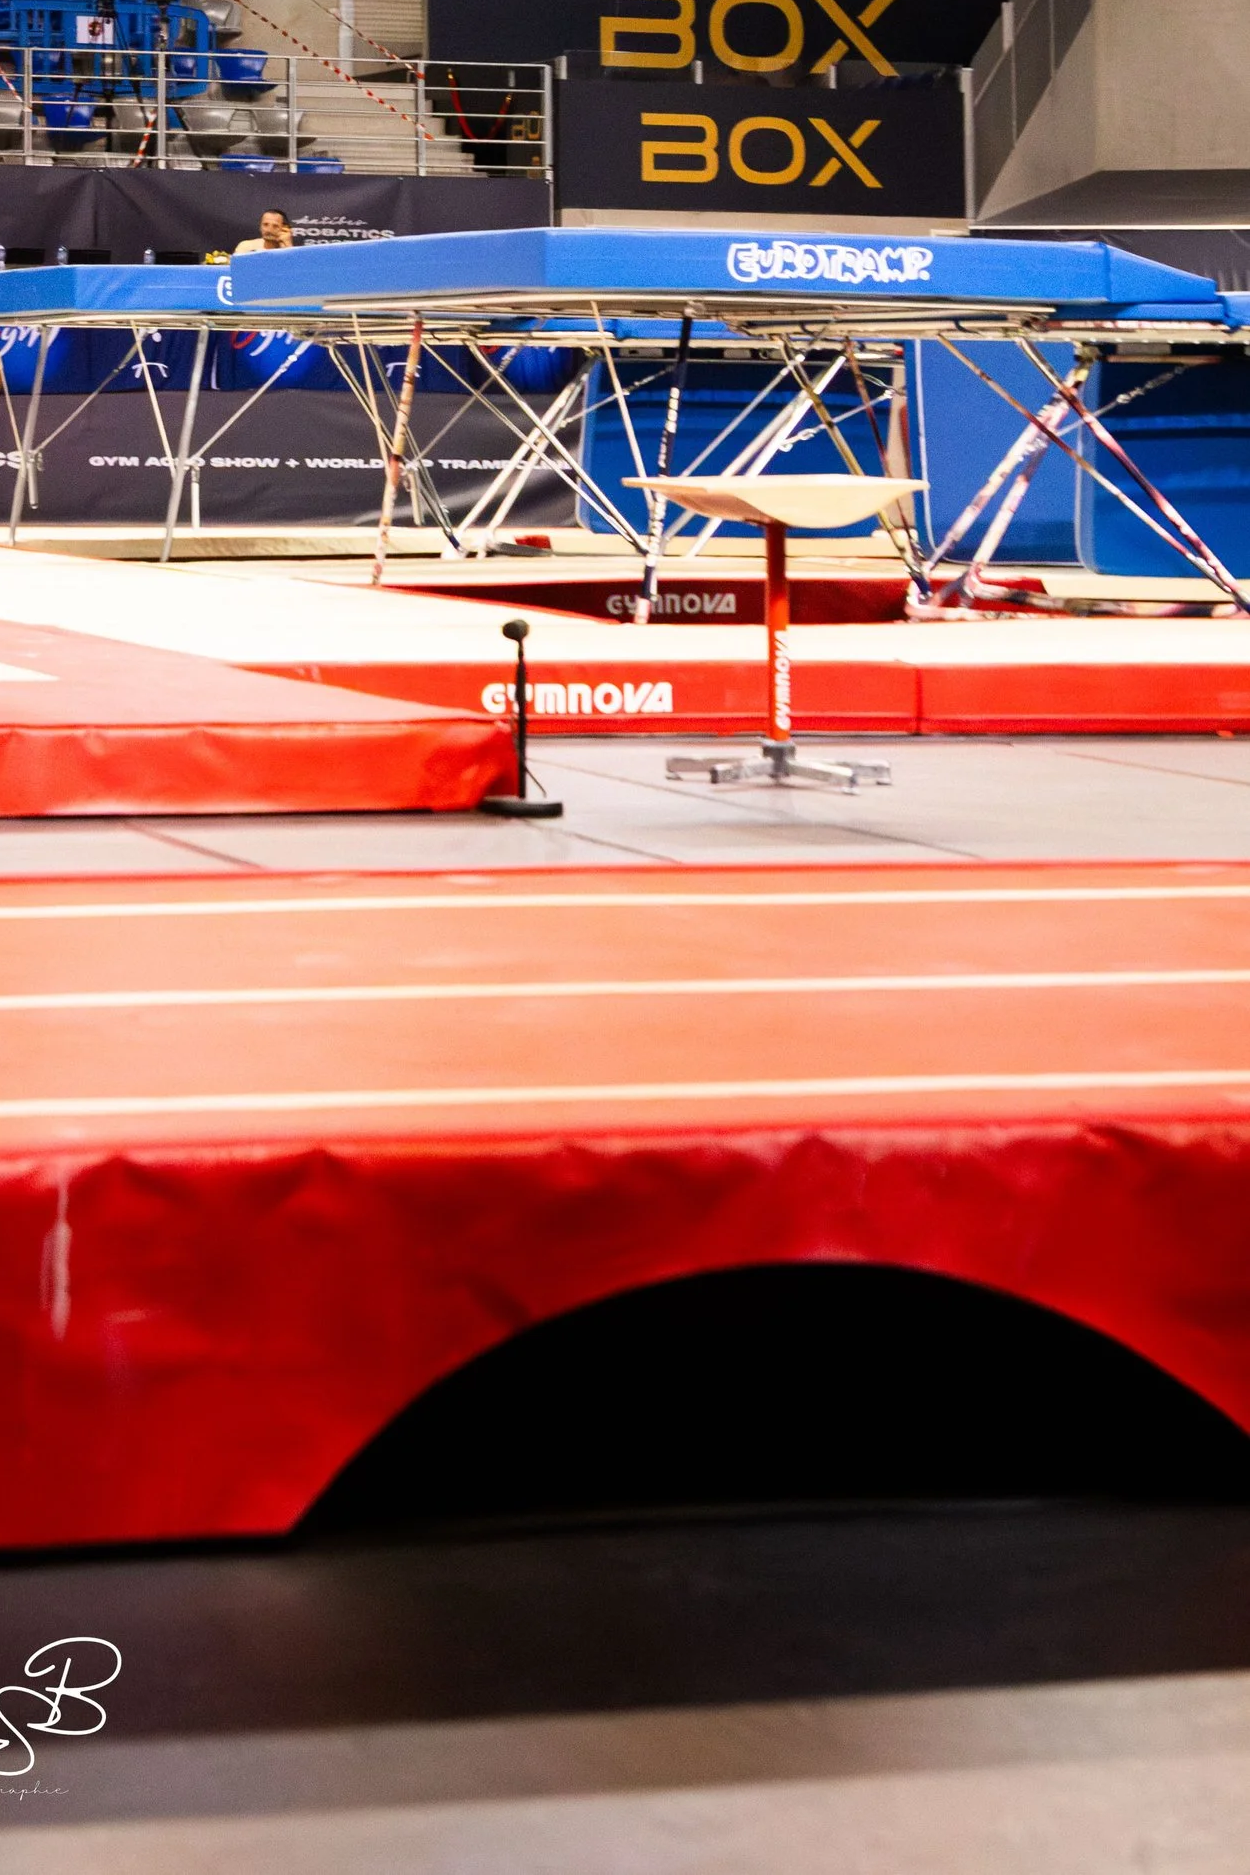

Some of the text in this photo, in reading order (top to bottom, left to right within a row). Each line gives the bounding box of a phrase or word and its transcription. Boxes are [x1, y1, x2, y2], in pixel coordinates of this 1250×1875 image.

[641, 113, 883, 189] BOX
[88, 456, 140, 467] GYM
[210, 457, 280, 468] SHOW
[304, 458, 385, 469] WORLD
